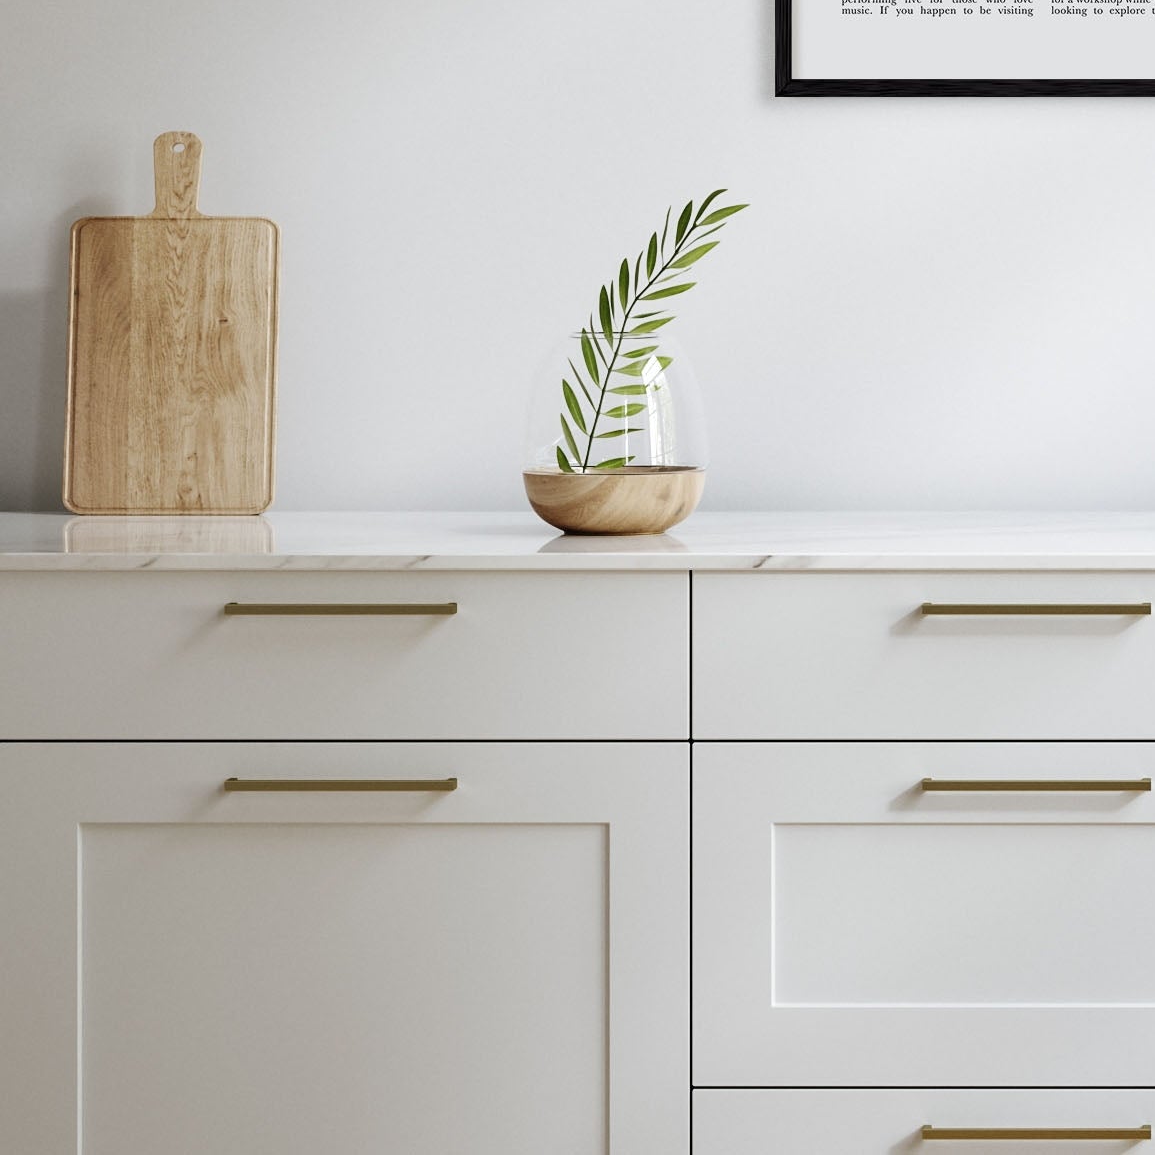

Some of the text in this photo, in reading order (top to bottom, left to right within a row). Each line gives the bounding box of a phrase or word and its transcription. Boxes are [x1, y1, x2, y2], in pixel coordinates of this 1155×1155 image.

[842, 6, 1034, 17] music. If you happen to be visiting
[1051, 6, 1088, 17] looking
[1093, 6, 1104, 15] to
[1109, 6, 1146, 17] explore
